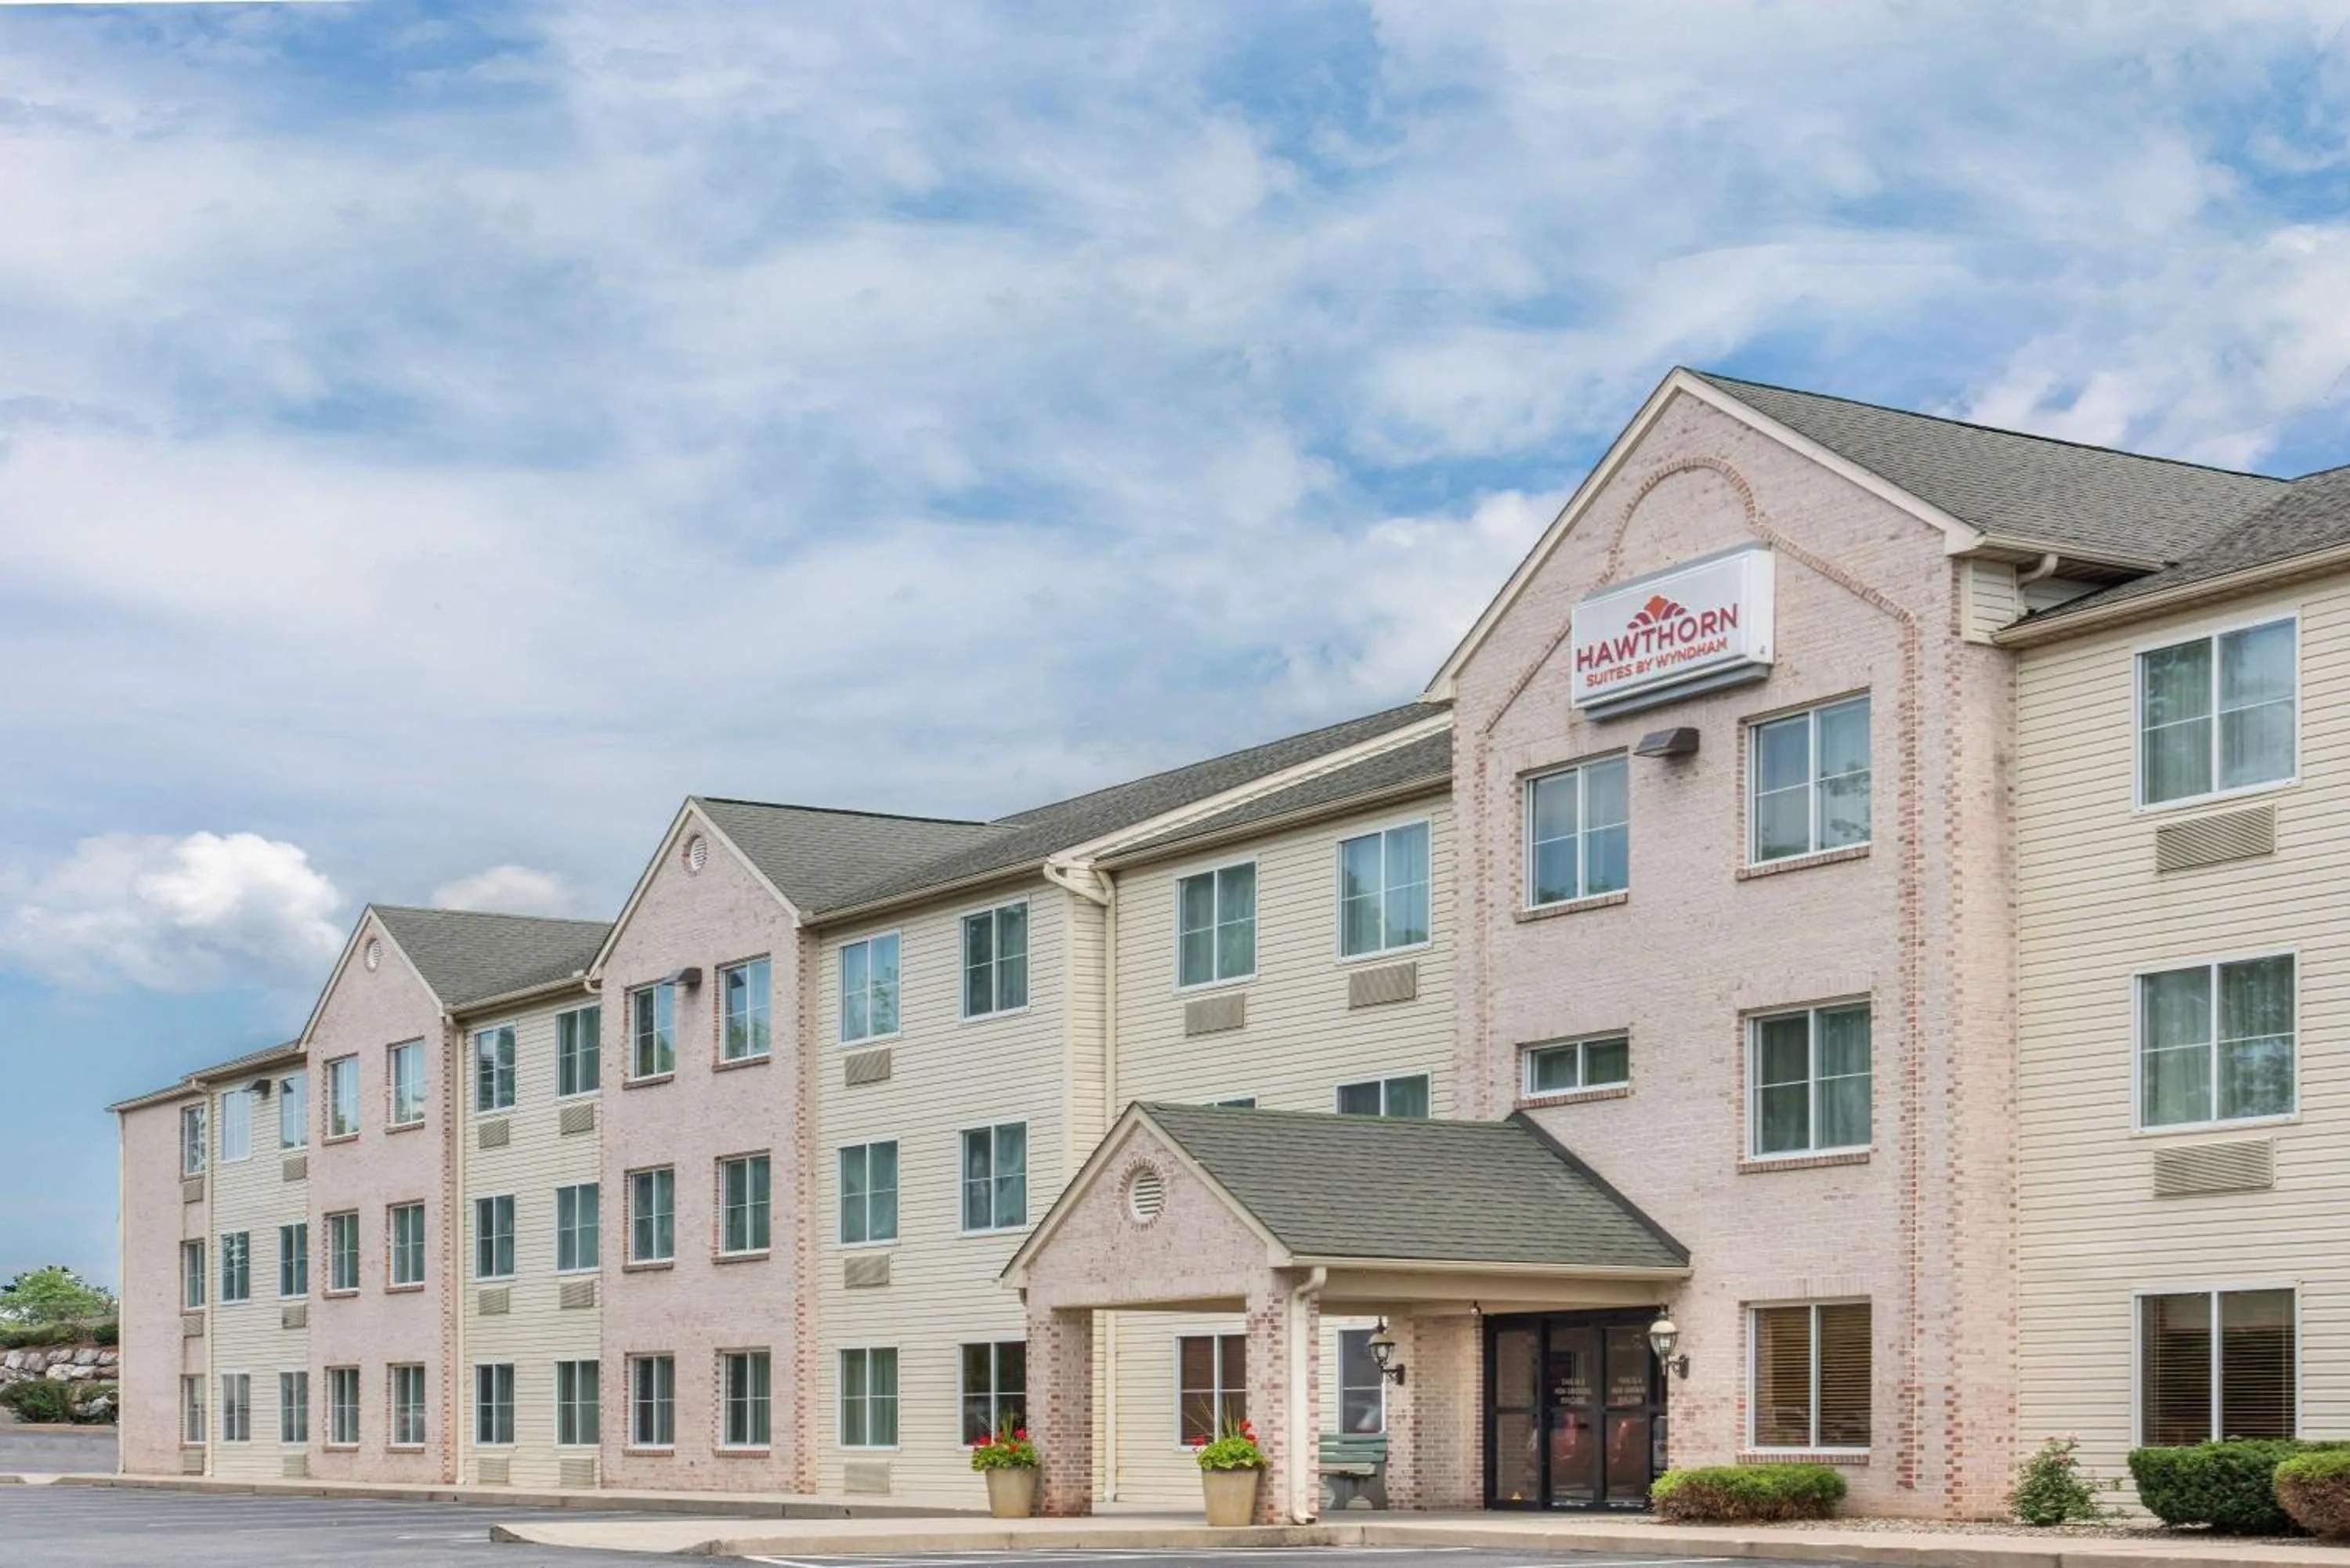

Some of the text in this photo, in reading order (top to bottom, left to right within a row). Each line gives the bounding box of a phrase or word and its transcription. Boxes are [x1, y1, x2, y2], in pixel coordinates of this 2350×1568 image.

[1577, 603, 1737, 672] HAWTHORN
[1585, 637, 1728, 687] SUITES BY WYNDHAM
